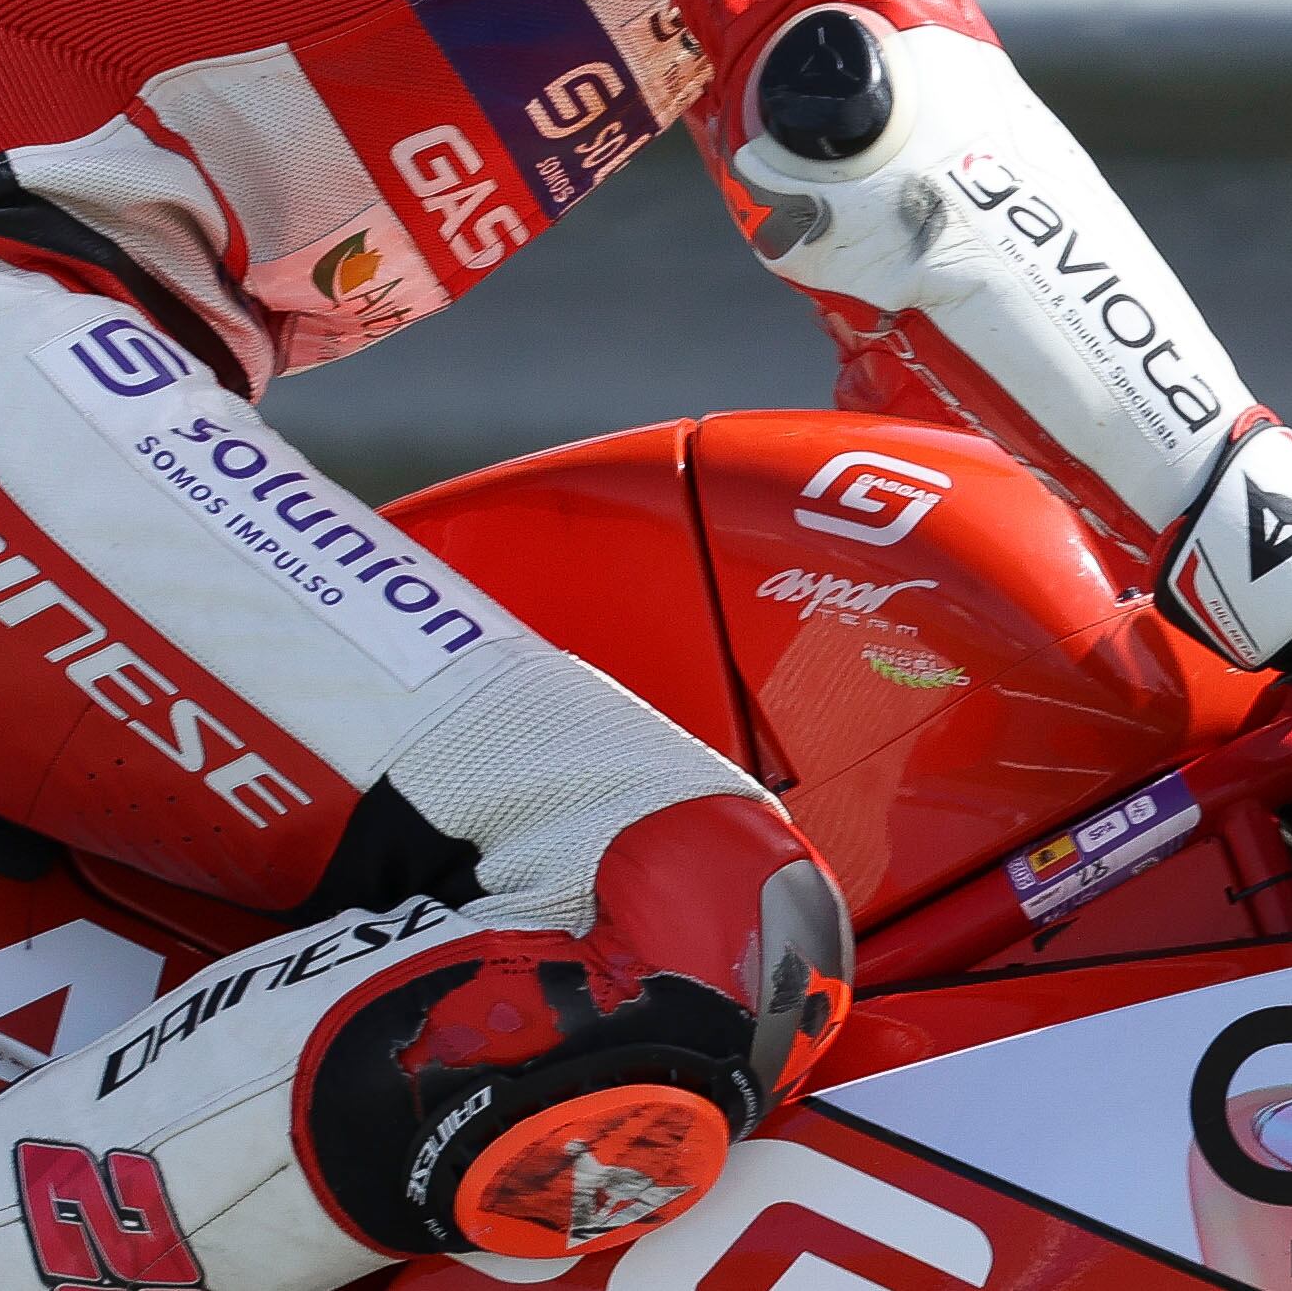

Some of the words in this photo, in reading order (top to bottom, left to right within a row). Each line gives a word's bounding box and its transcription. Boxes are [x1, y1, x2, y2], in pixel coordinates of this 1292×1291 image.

[389, 124, 531, 270] GAS
[947, 153, 1221, 434] gaviota
[135, 434, 229, 515] SOMOS
[224, 512, 345, 607] IMPULSO
[169, 416, 484, 655] solunion
[756, 567, 941, 621] aspar
[96, 898, 447, 1101] DAINESE
